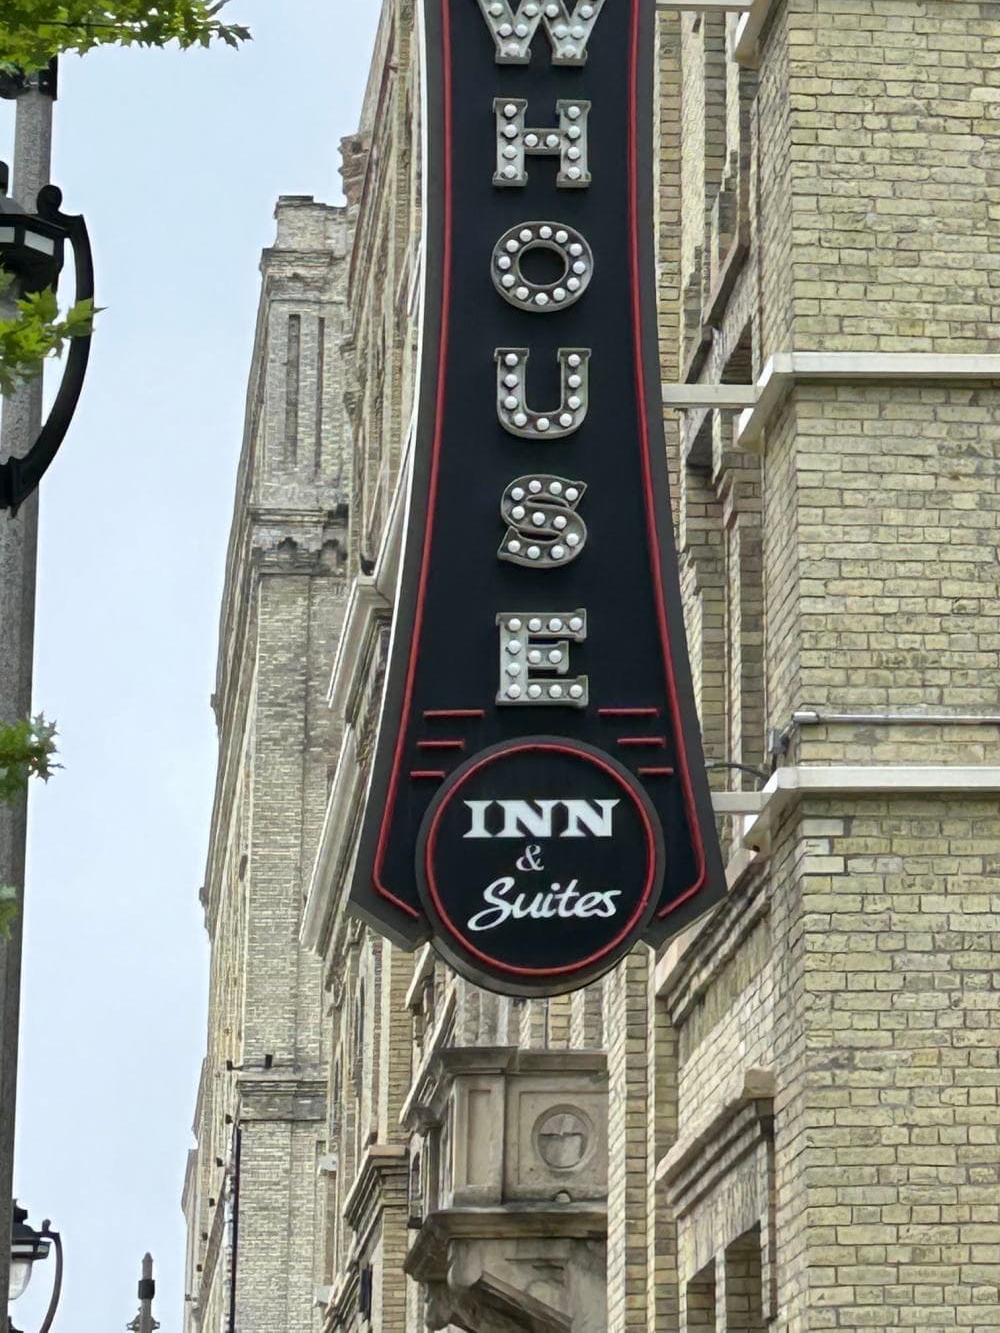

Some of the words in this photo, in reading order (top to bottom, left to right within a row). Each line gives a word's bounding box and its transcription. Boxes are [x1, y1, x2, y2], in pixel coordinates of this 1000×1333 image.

[463, 798, 621, 838] INN
[515, 844, 545, 872] &
[467, 876, 622, 932] Suites
